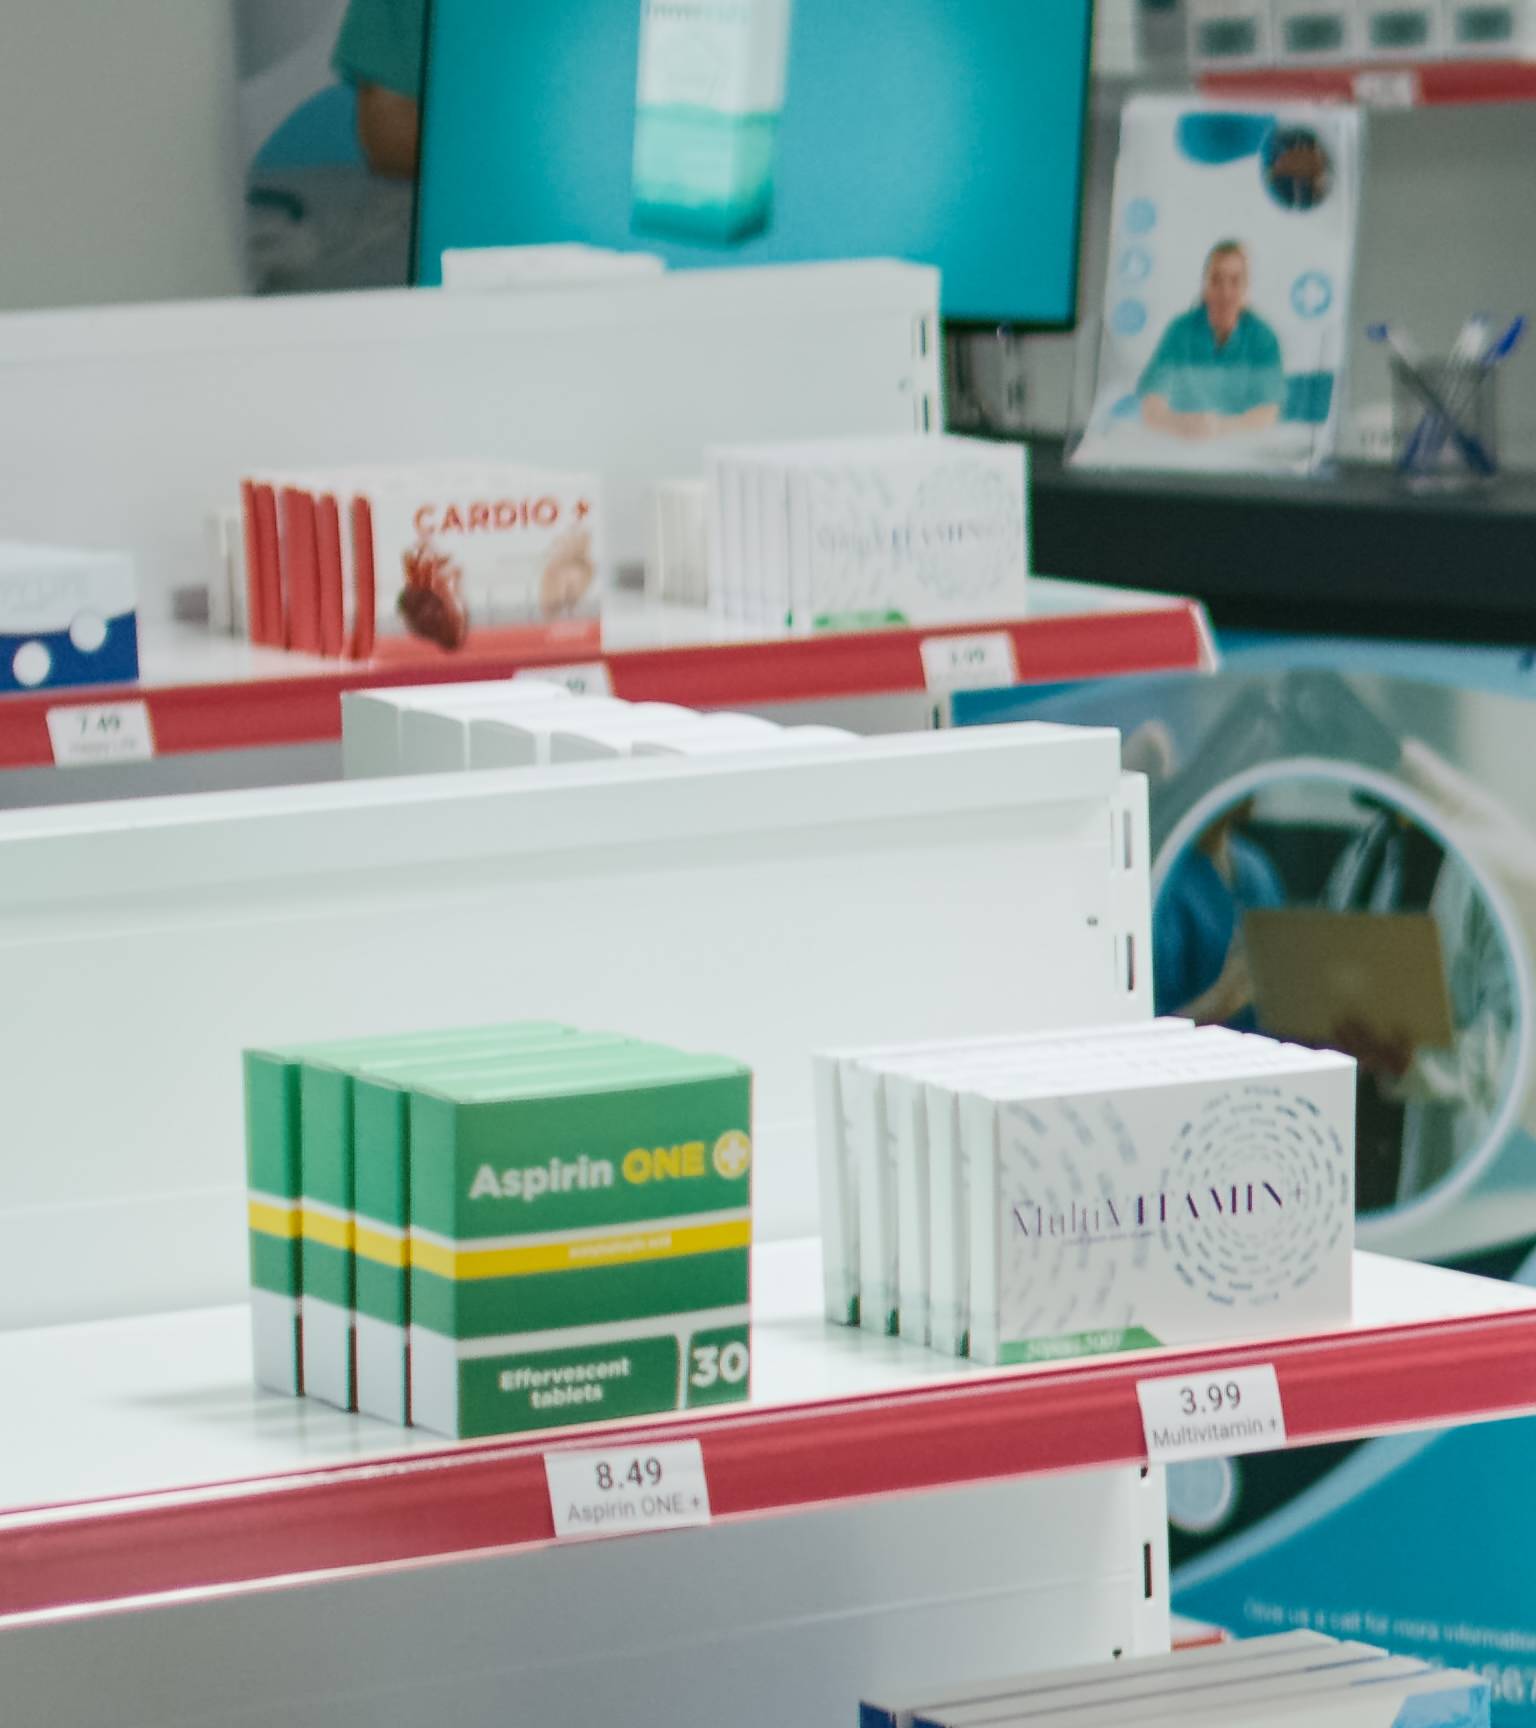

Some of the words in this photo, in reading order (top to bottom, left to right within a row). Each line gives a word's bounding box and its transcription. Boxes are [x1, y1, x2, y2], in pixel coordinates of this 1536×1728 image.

[415, 498, 558, 536] CARDIO
[469, 1155, 614, 1203] Aspirin
[622, 1143, 706, 1184] ONE
[500, 1356, 631, 1393] Effervescent
[691, 1341, 750, 1388] 30
[531, 1382, 604, 1410] tablets
[1180, 1381, 1242, 1415] 3.99
[1152, 1416, 1265, 1450] Multivitamin
[595, 1456, 662, 1491] 8.49
[567, 1500, 636, 1526] Aspirin
[641, 1496, 686, 1519] ONE
